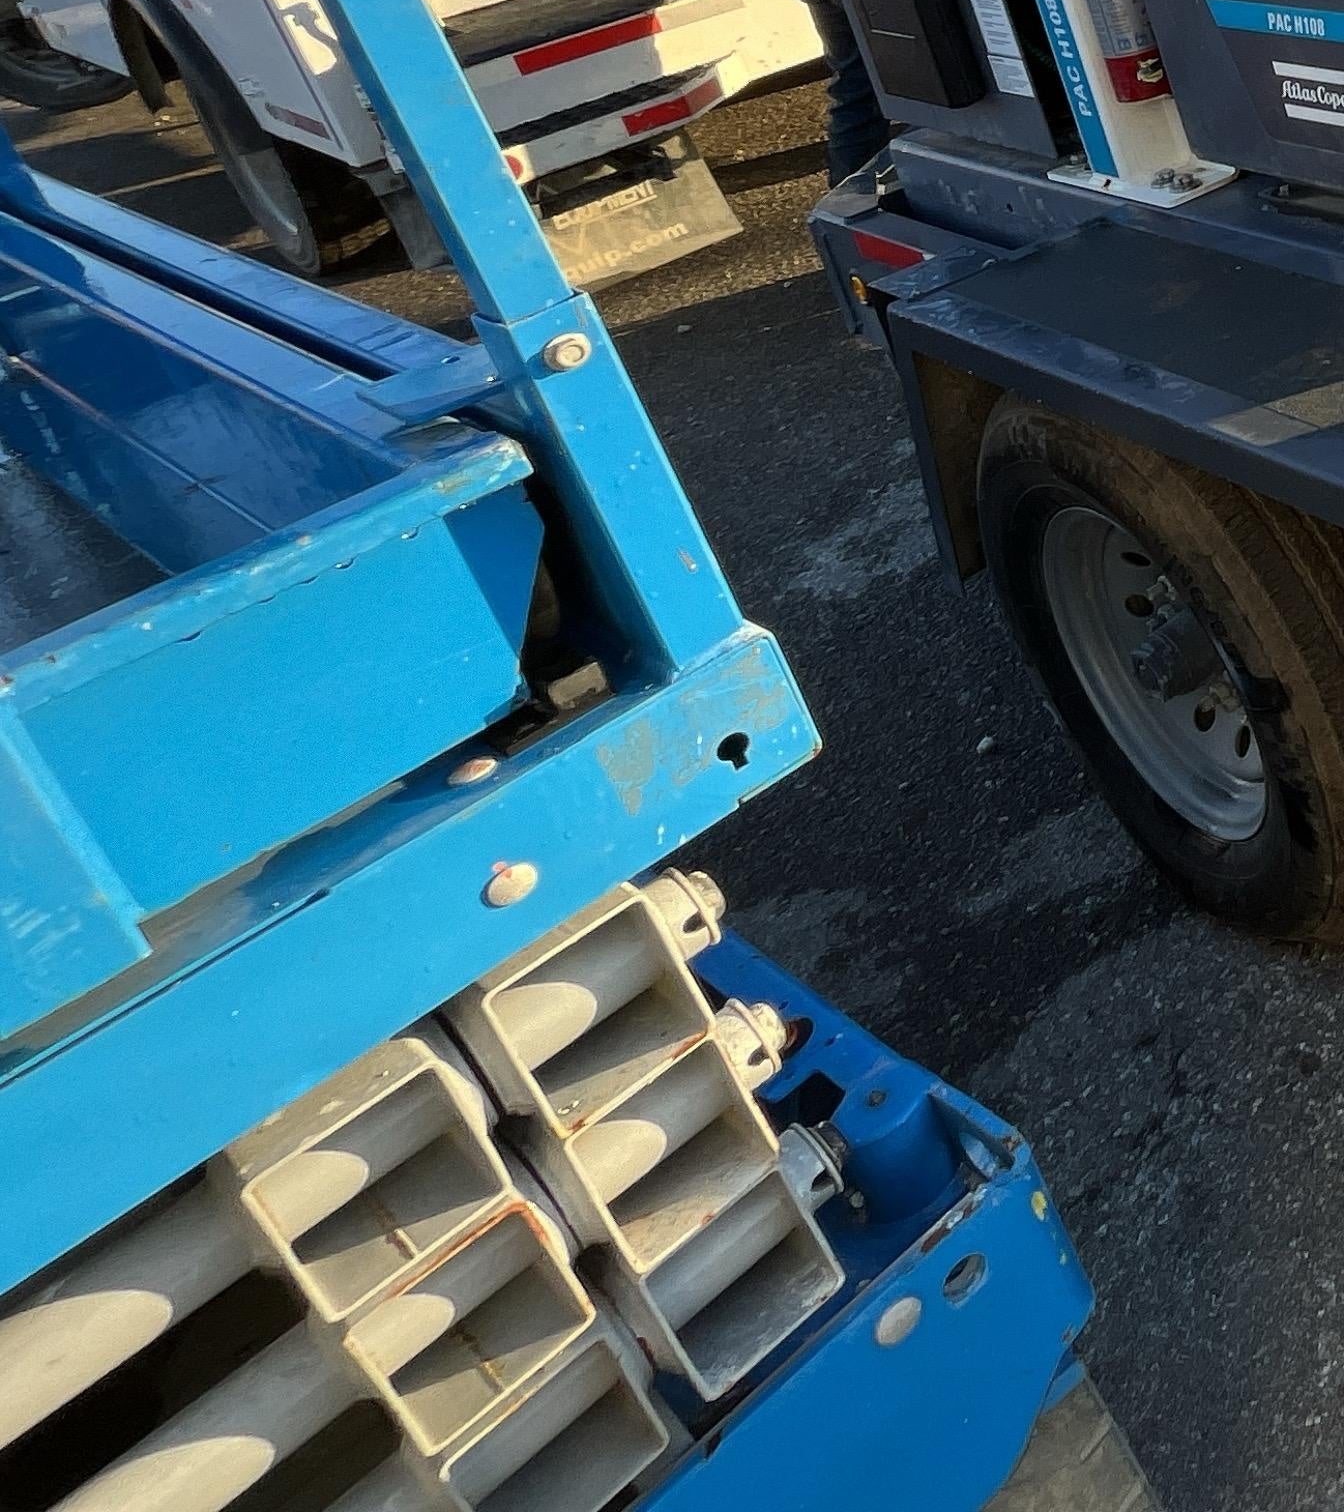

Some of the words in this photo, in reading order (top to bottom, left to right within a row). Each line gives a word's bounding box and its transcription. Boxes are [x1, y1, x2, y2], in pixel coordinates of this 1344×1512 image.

[1266, 12, 1293, 33] PAC
[1294, 15, 1325, 36] H108
[1066, 65, 1093, 117] PAC
